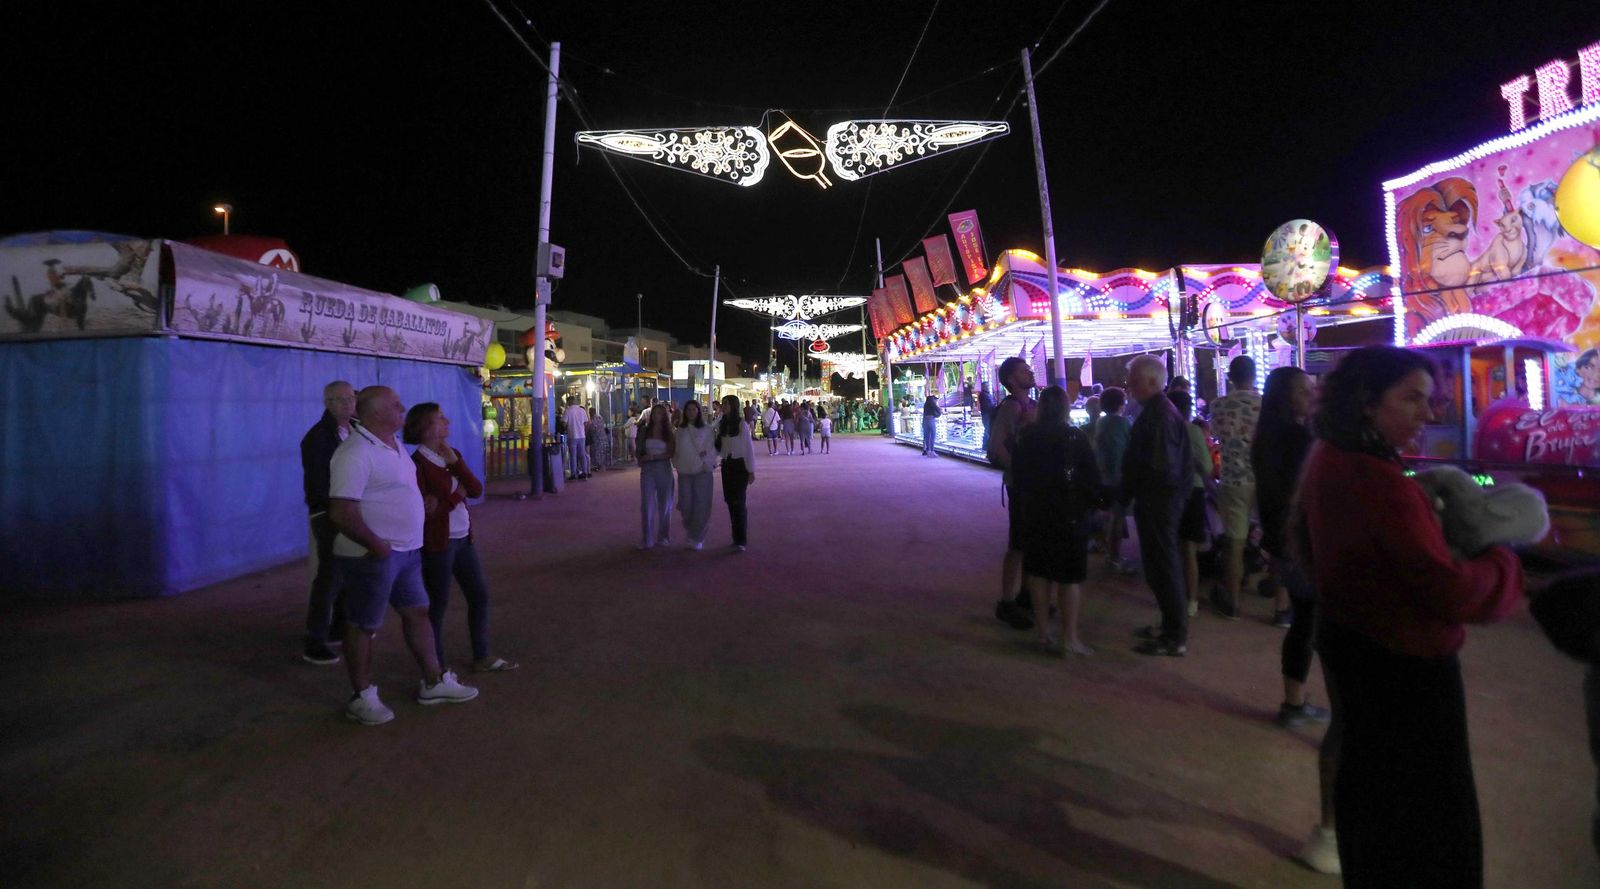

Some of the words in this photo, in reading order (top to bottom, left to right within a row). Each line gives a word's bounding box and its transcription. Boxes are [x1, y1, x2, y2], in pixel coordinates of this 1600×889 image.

[299, 291, 354, 321] RUEDA
[358, 303, 377, 324] DE
[379, 305, 447, 337] CABALLITOS
